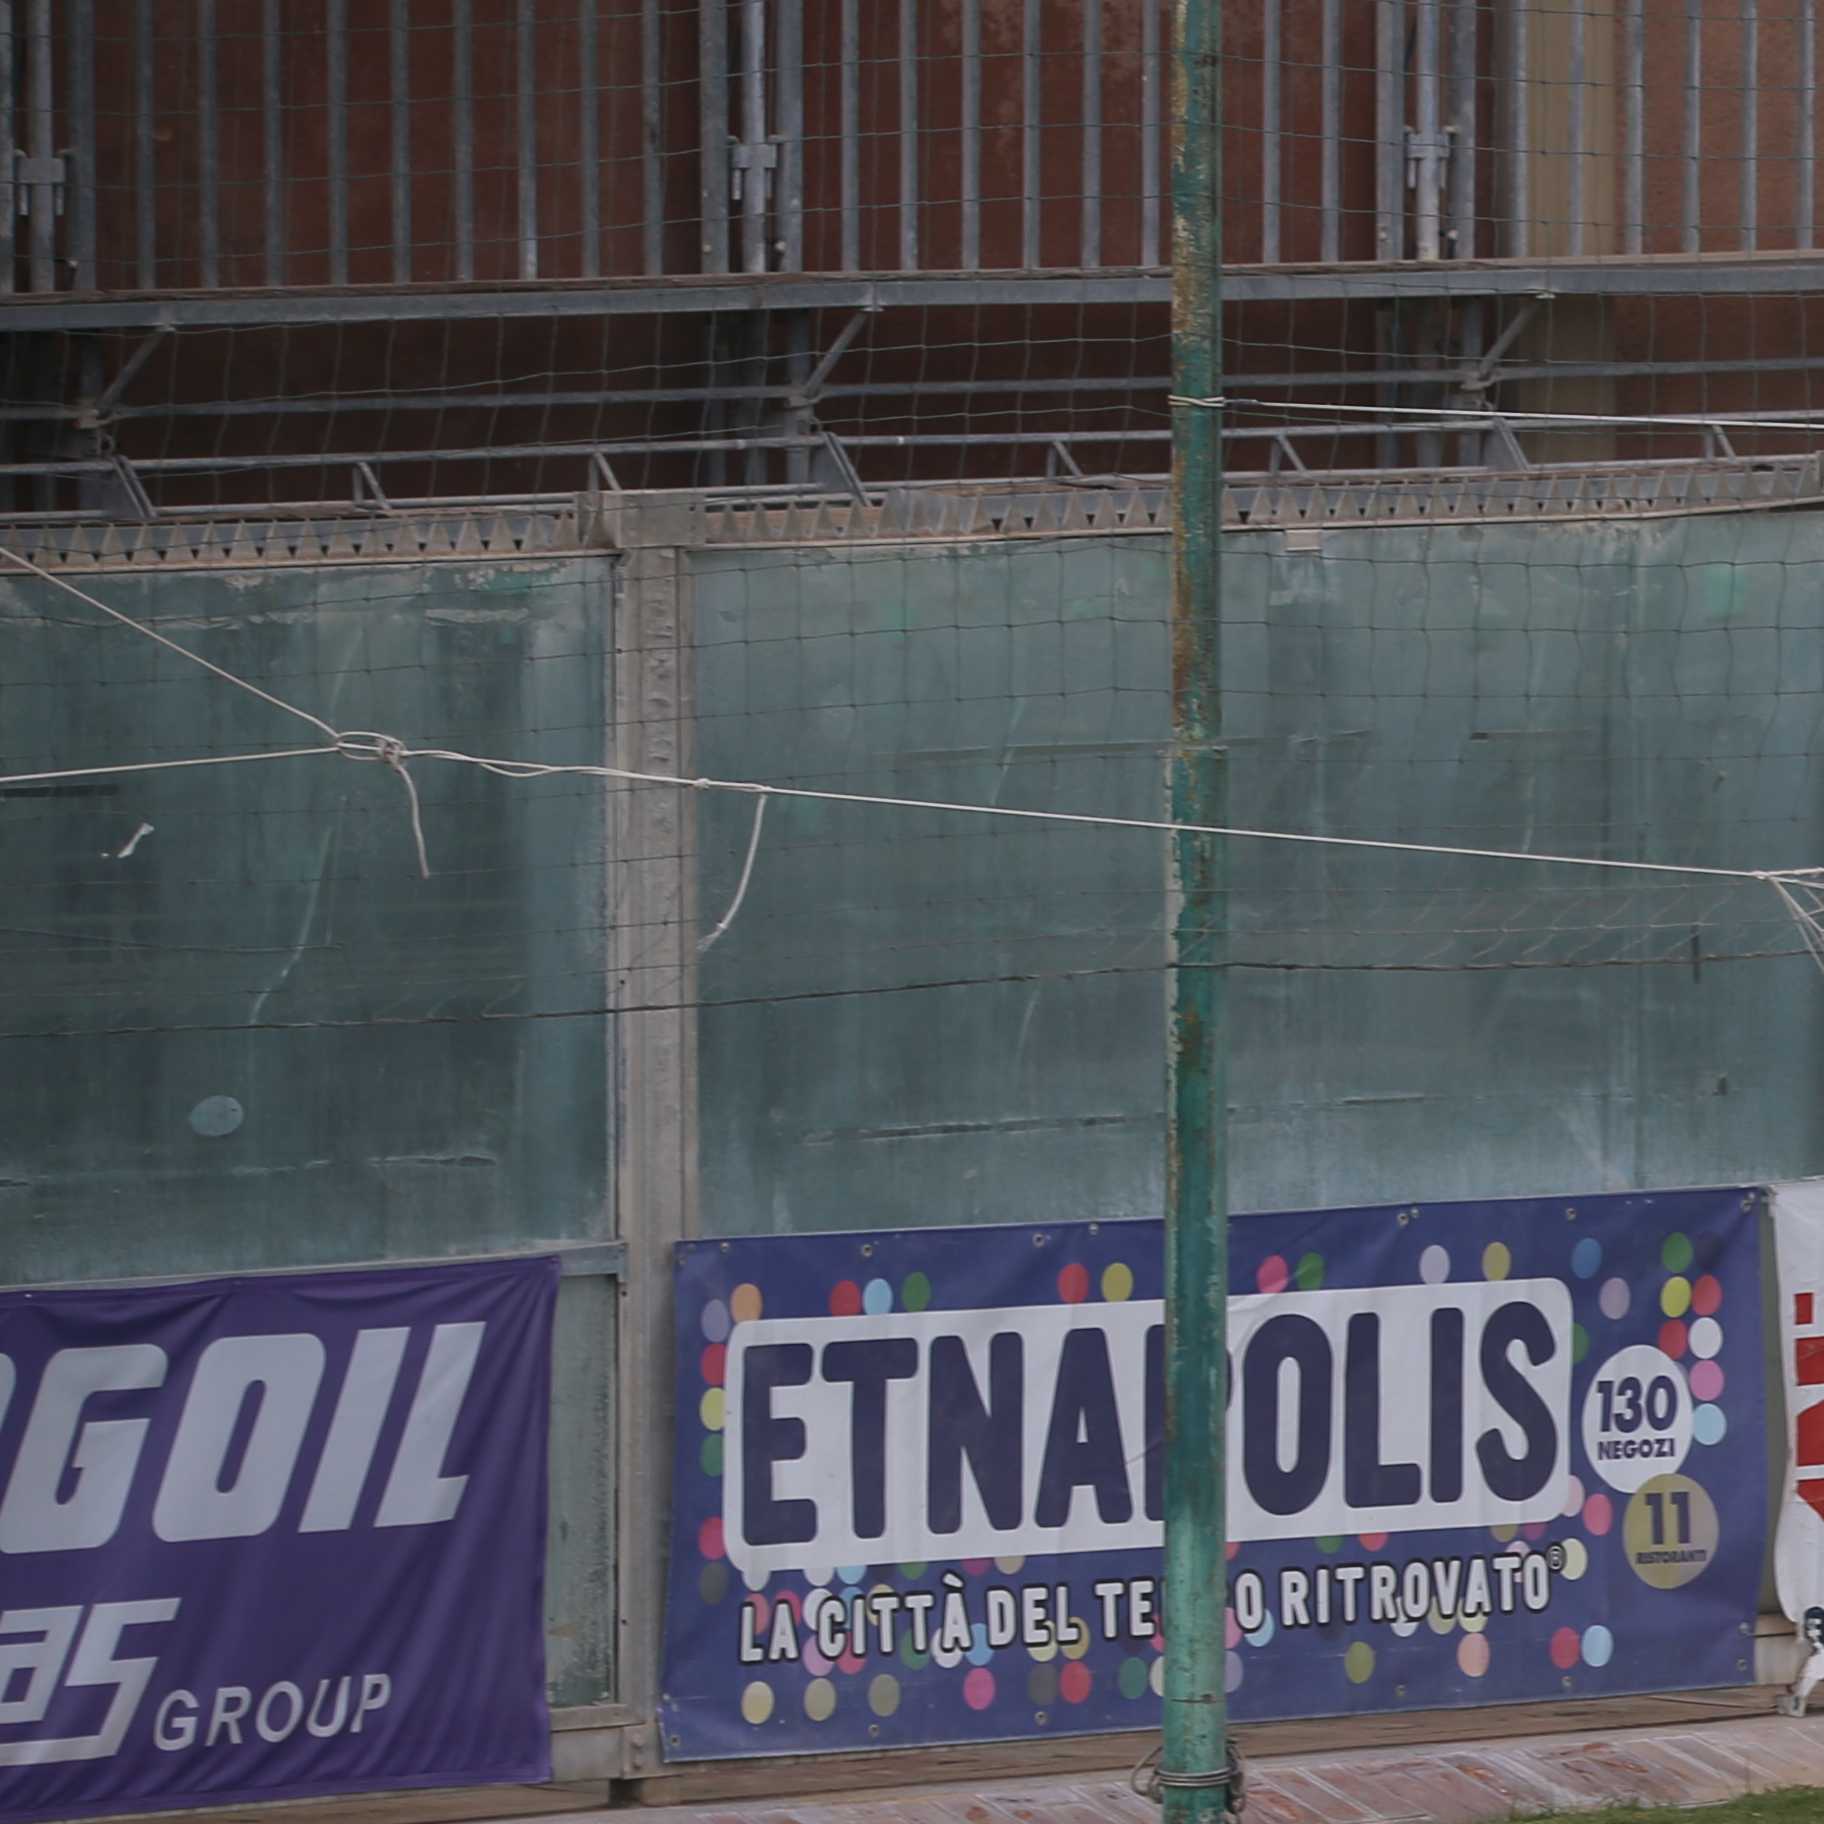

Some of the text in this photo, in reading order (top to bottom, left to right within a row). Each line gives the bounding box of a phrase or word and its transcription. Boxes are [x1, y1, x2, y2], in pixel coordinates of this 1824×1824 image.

[1596, 1375, 1678, 1433] 130
[1597, 1438, 1675, 1460] NEGOZI
[1645, 1491, 1690, 1545] 11
[740, 1600, 799, 1663] LA
[816, 1572, 972, 1659] CITTÀ
[986, 1585, 1080, 1648] DEL
[1095, 1570, 1266, 1640] TEO
[153, 1672, 392, 1752] GROUP
